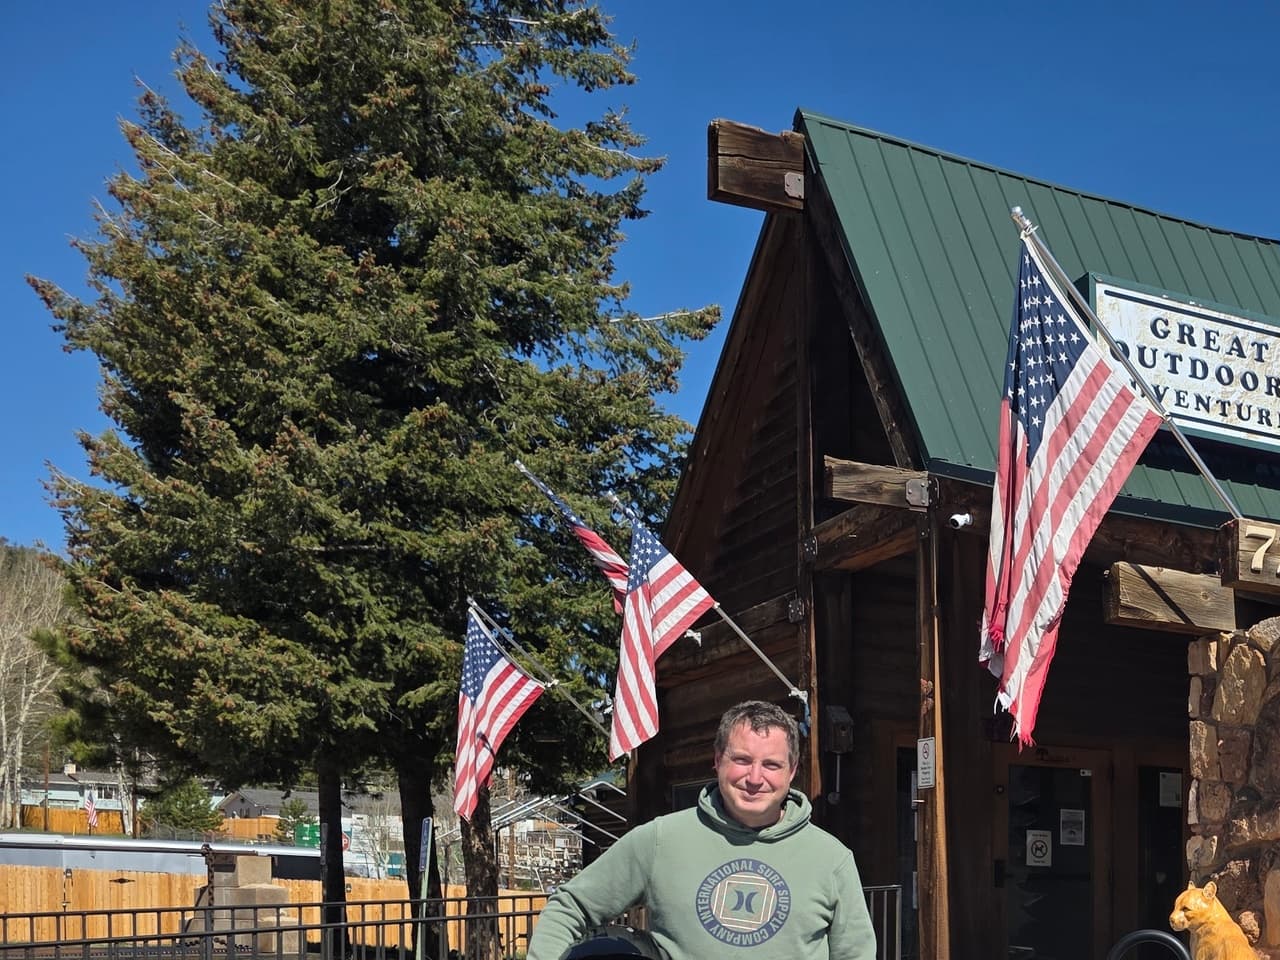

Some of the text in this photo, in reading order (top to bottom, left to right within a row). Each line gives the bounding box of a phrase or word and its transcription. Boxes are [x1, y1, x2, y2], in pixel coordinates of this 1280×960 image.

[1150, 317, 1269, 363] GREAT
[698, 861, 790, 945] INTERNATIONAL SURF SUPPLY COMPANY
